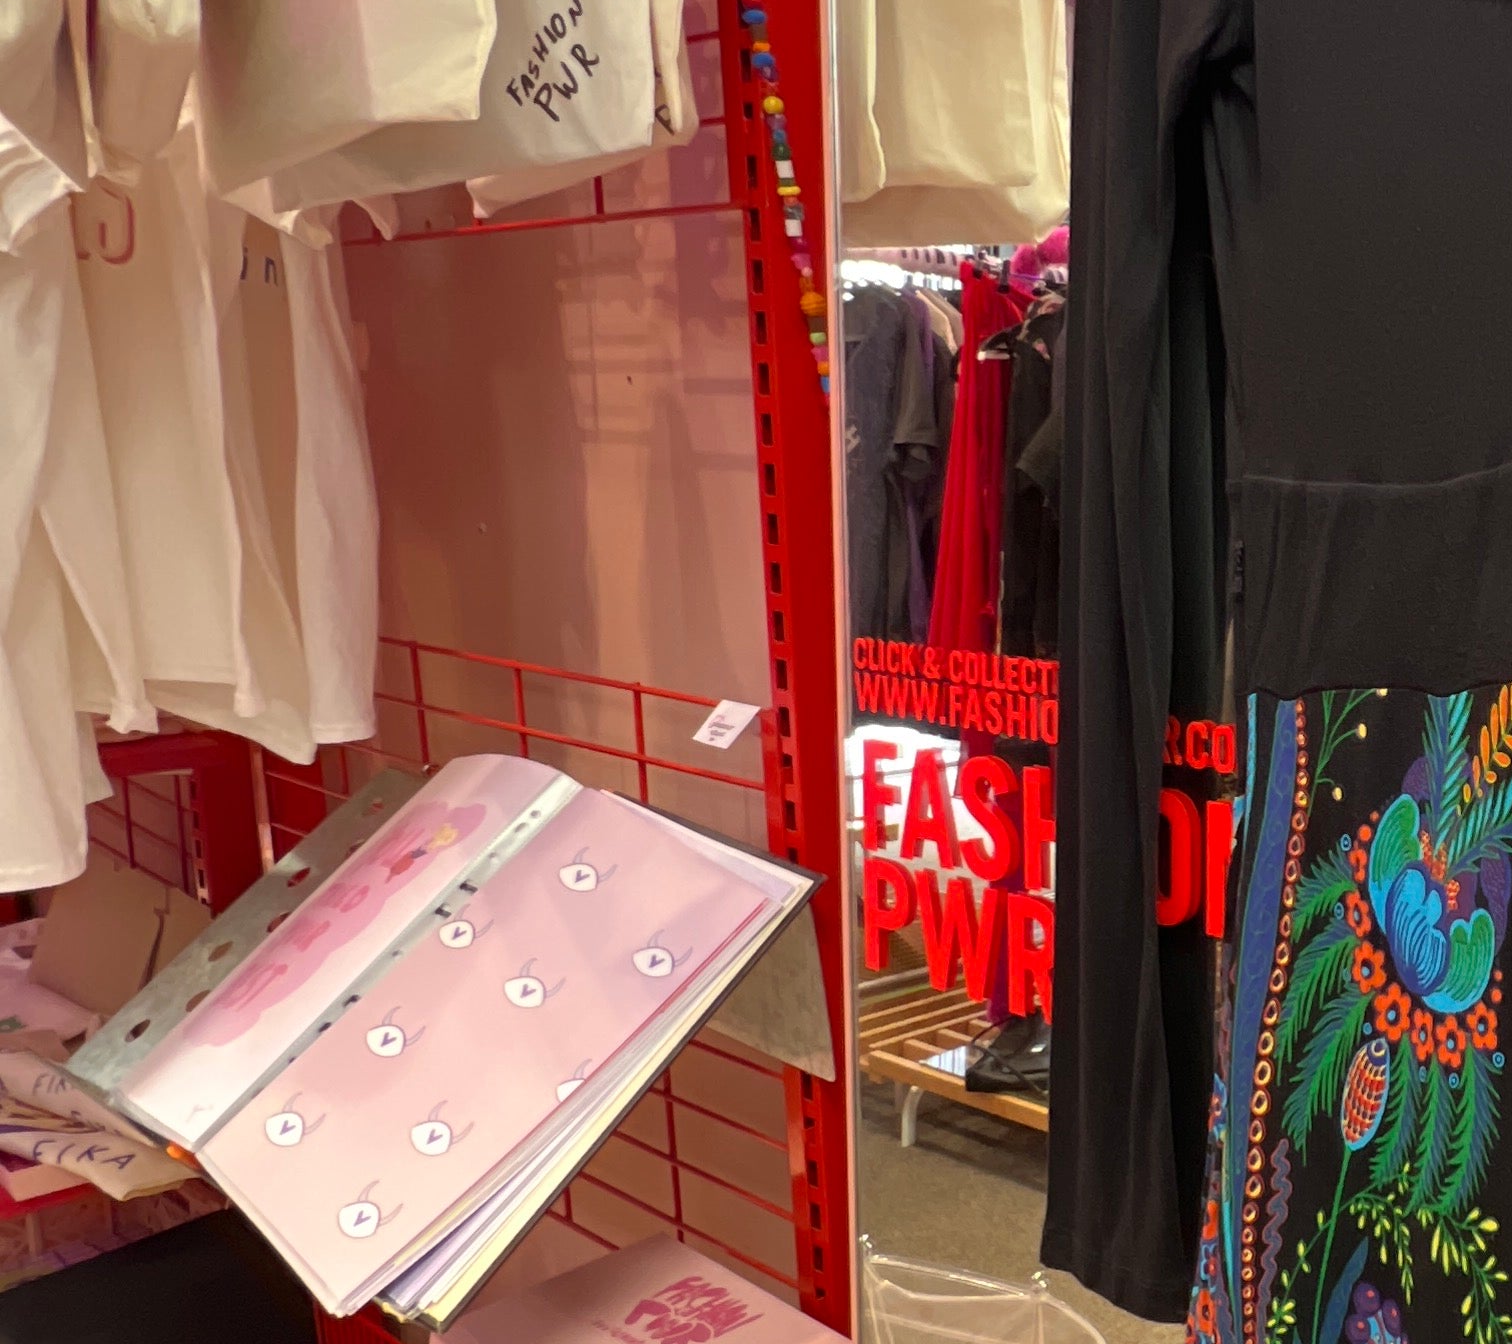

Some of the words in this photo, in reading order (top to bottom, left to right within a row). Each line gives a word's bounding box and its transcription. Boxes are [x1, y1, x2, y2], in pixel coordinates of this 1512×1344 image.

[533, 42, 601, 123] PWR
[854, 637, 917, 677] CLICK
[922, 646, 942, 680] &
[864, 856, 1056, 1026] PWR
[32, 1138, 137, 1171] FIKA
